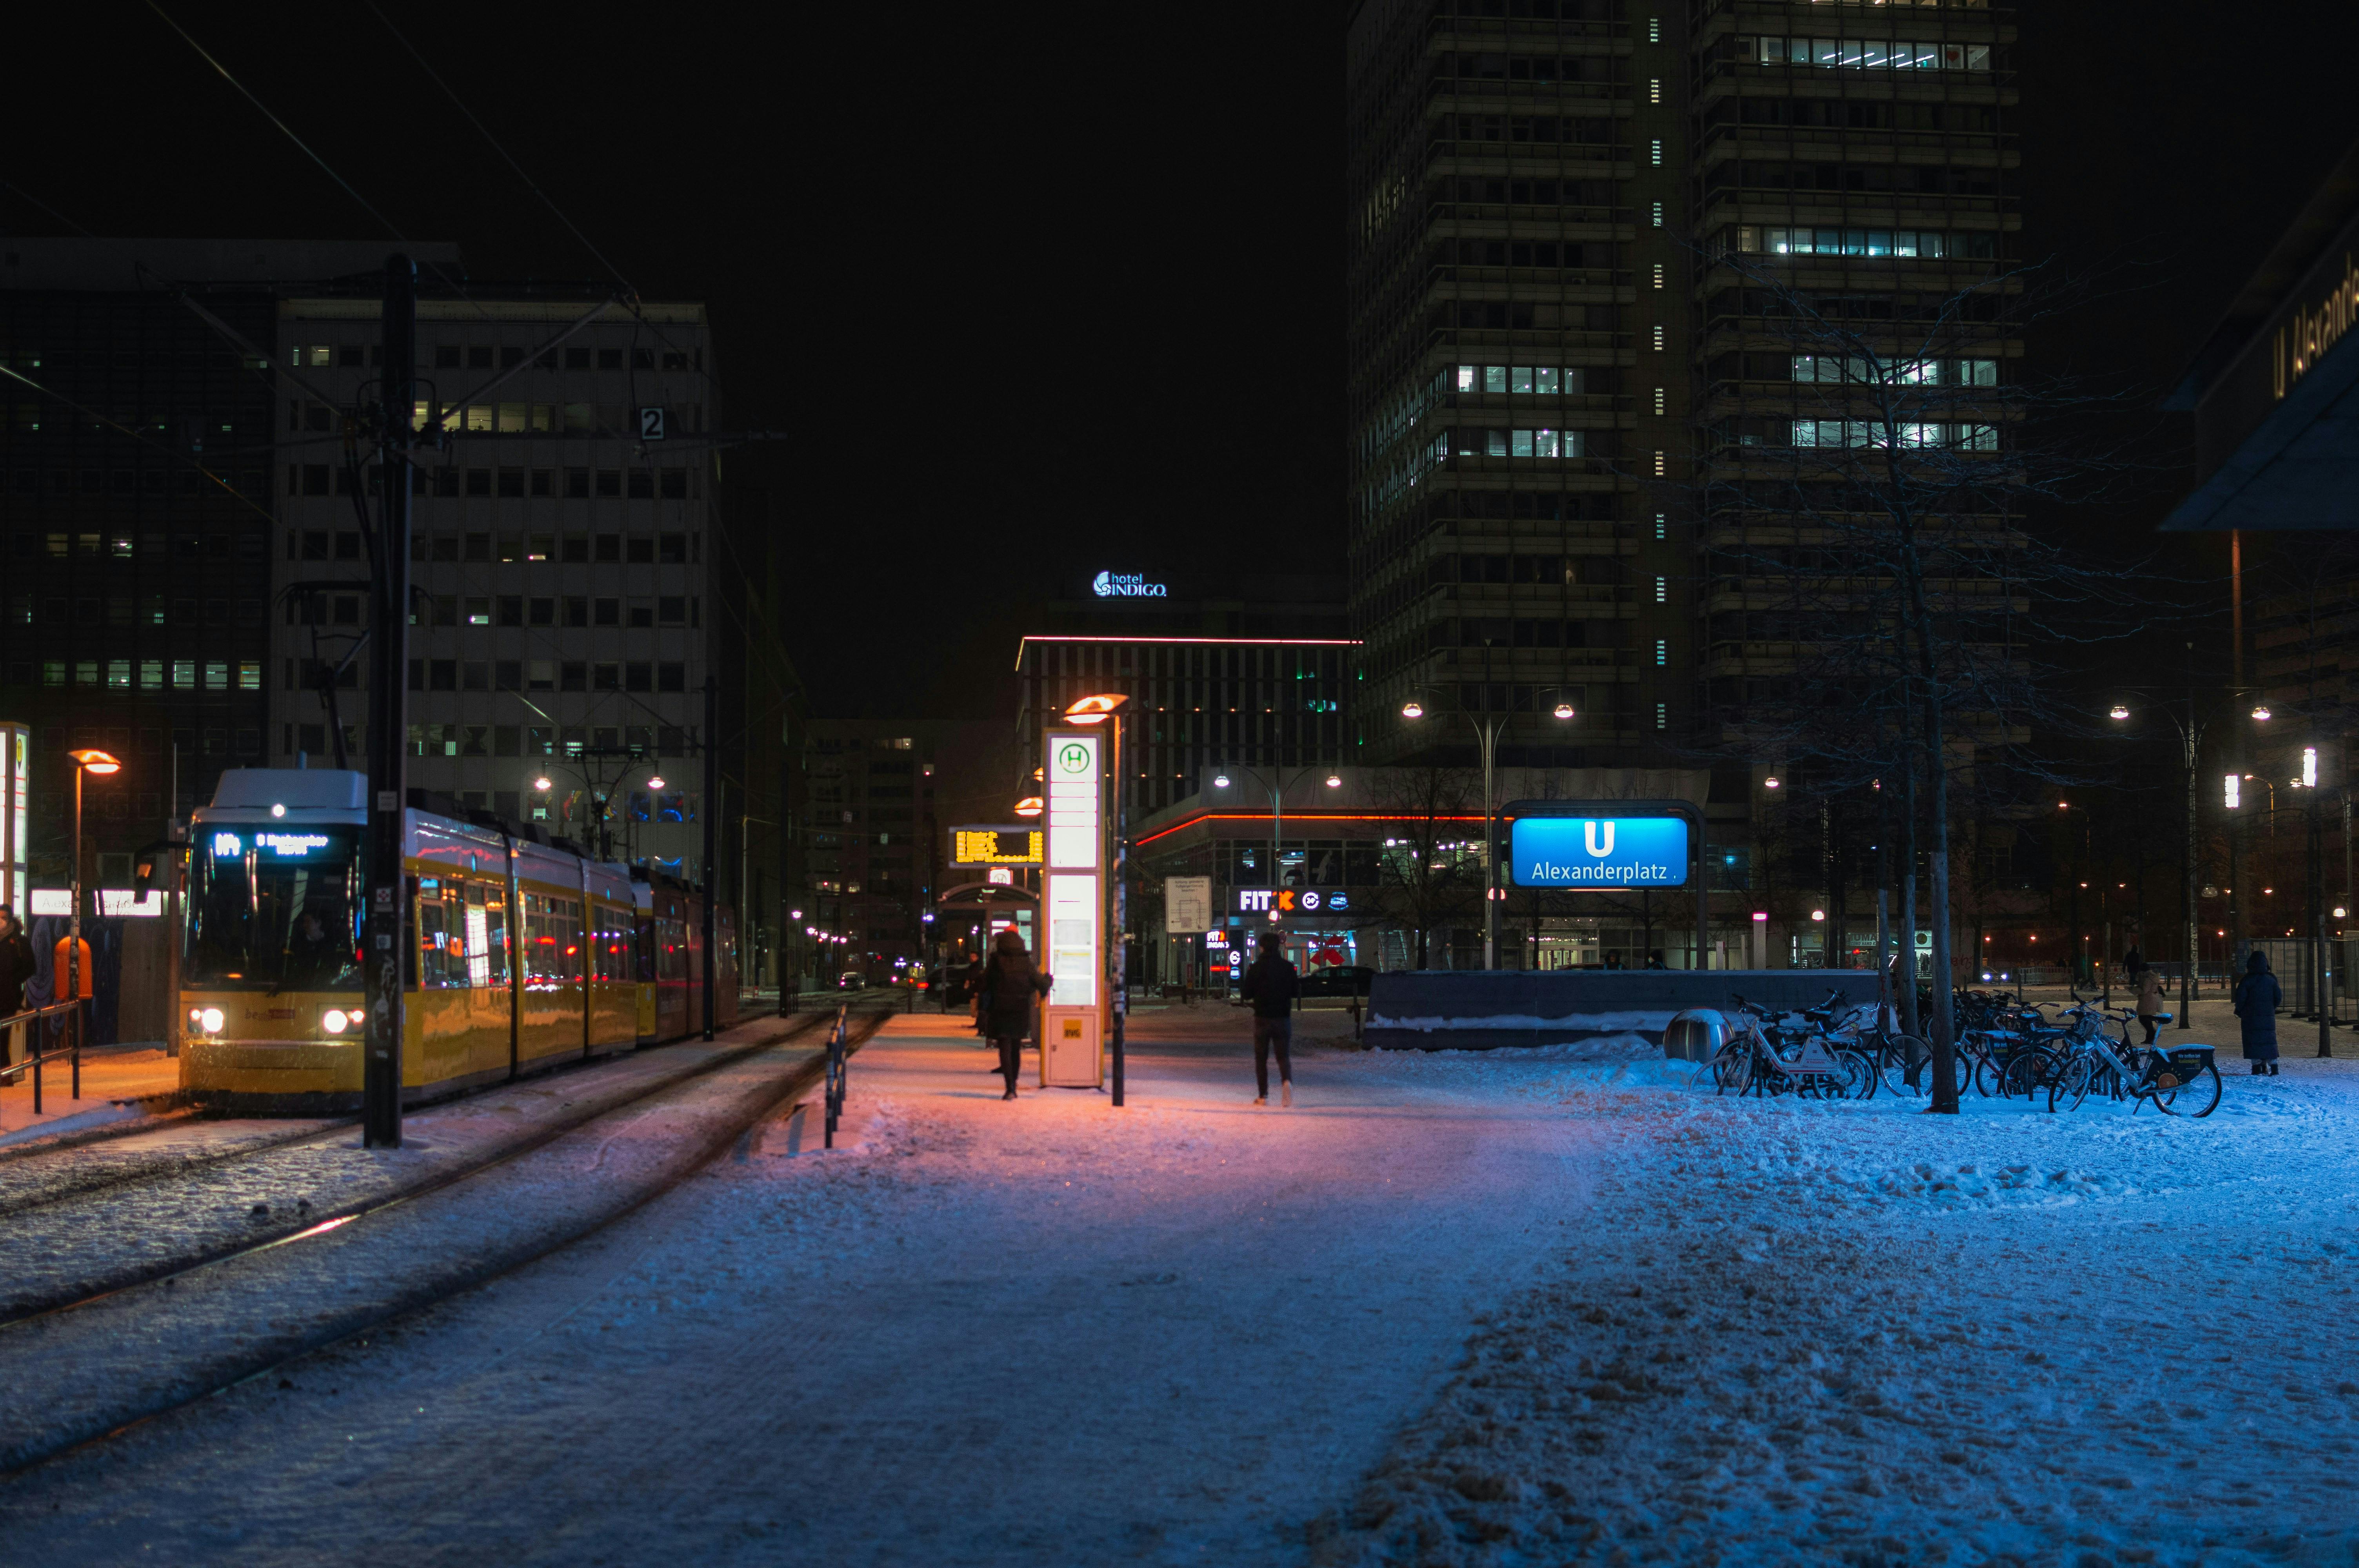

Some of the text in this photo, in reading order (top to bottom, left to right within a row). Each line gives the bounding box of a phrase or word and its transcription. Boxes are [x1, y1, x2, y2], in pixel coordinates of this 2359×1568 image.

[2274, 326, 2285, 400] U
[644, 410, 661, 436] 2
[1112, 573, 1142, 584] hotel
[1112, 584, 1166, 596] INDIGO
[1068, 751, 1081, 766] H
[1584, 821, 1615, 857] U
[1532, 862, 1667, 884] Alexanderplatz
